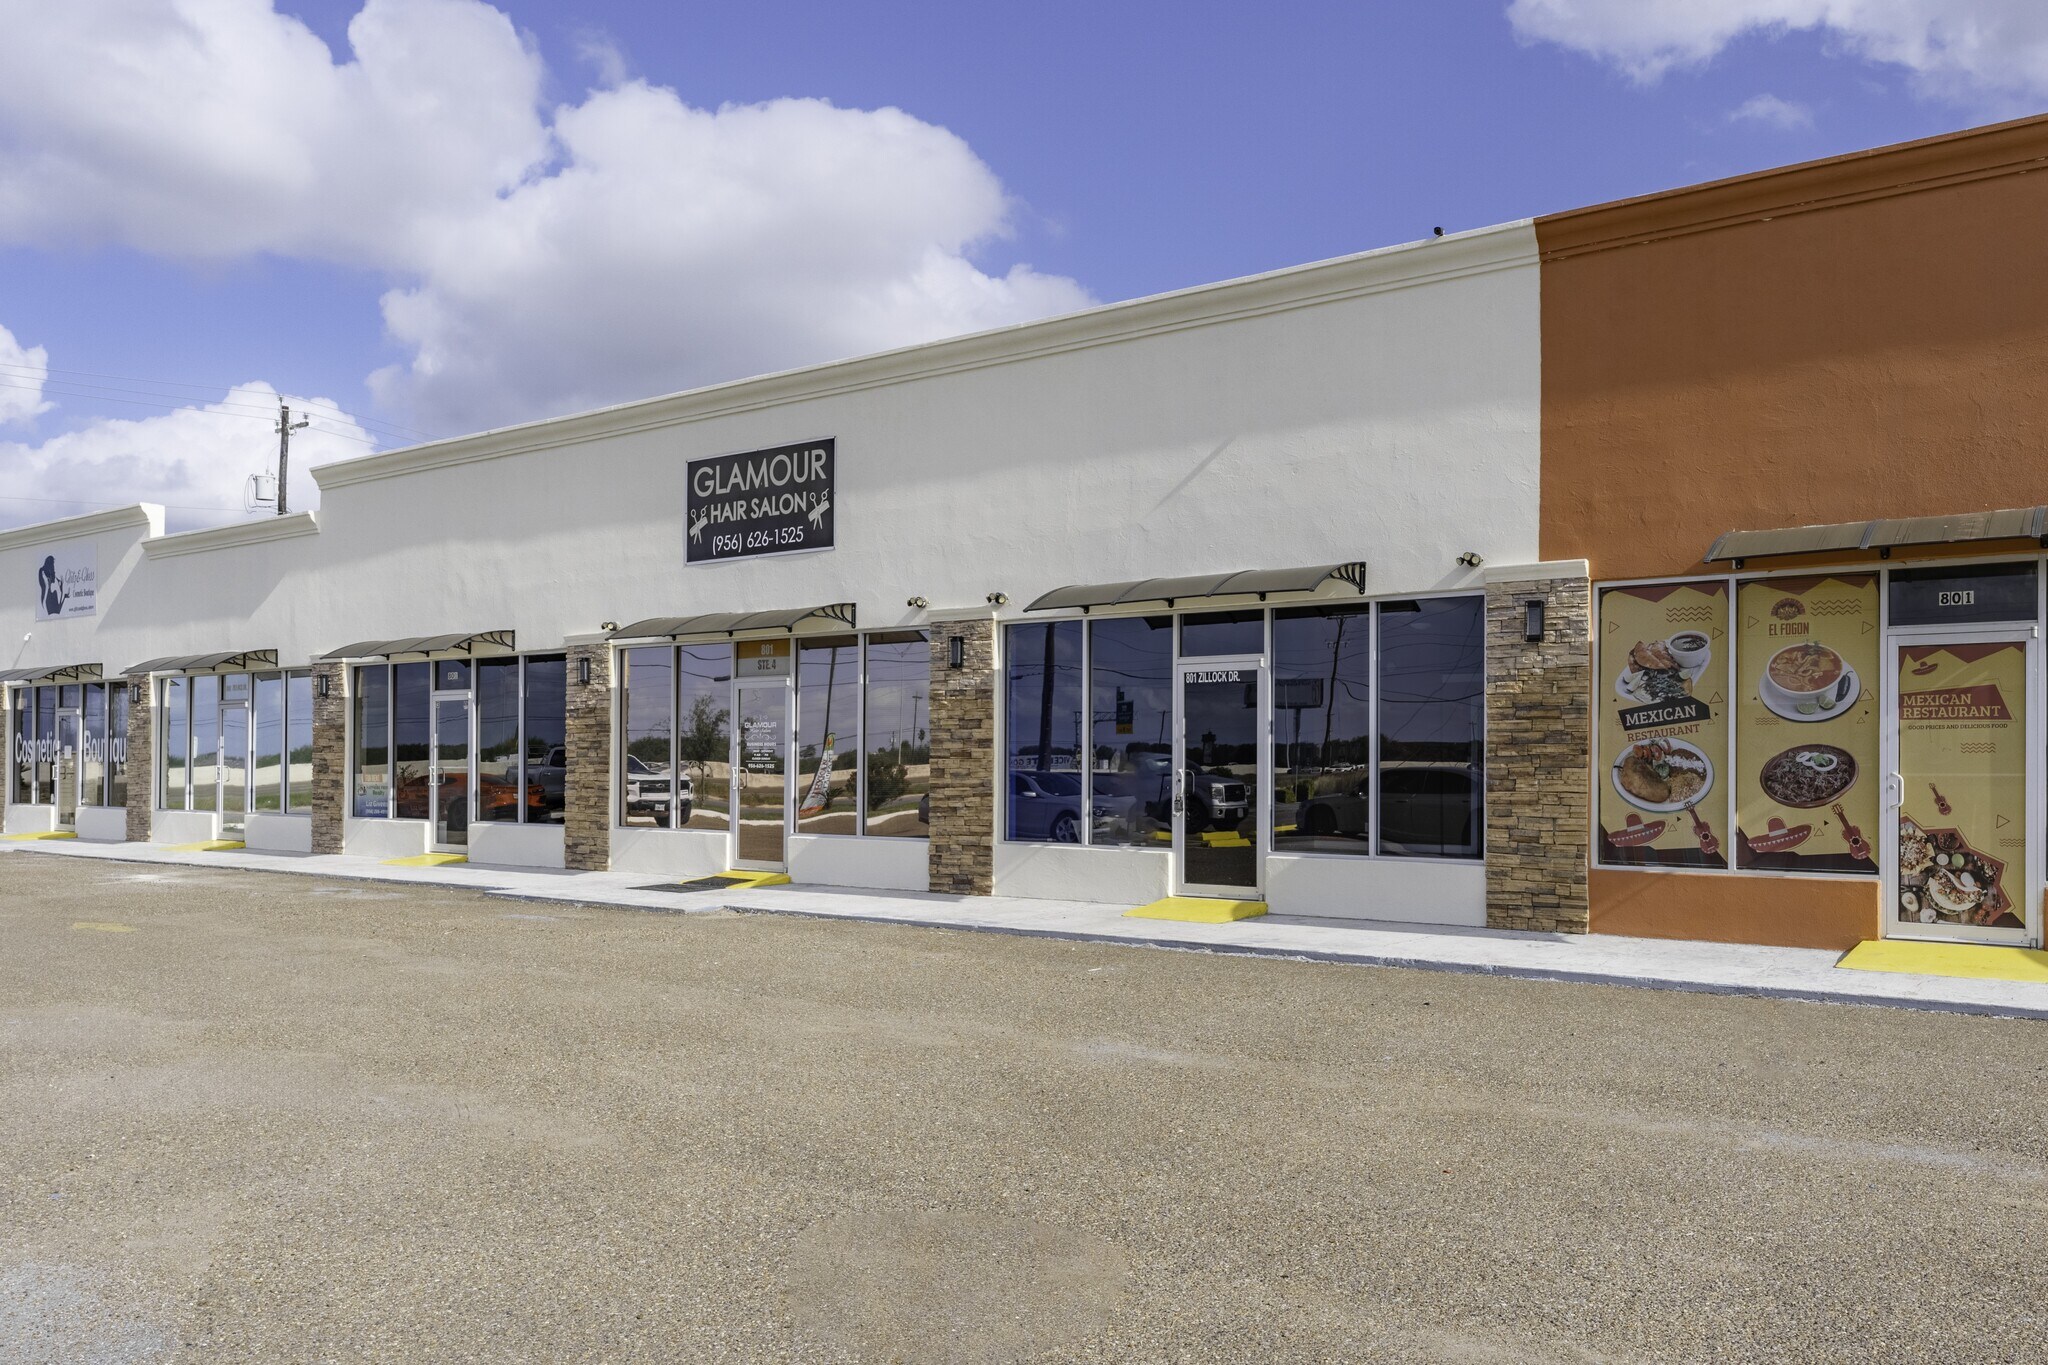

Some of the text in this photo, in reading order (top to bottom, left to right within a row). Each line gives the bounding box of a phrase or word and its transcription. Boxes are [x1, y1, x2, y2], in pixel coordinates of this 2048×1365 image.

[694, 448, 827, 497] GLAMOUR
[711, 491, 807, 524] HAIR SALON
[712, 525, 804, 555] (956) 626-1525
[1940, 591, 1973, 605] 801
[1768, 622, 1810, 636] EL FOGON
[760, 643, 774, 656] 801
[771, 659, 777, 670] 4
[1185, 671, 1240, 684] 801 ZILLOCK DR.
[1903, 693, 1972, 706] MEXICAN
[1625, 704, 1697, 727] MEXICAN
[1902, 705, 2001, 719] RESTAURANT
[1627, 724, 1700, 742] RESTAURANT
